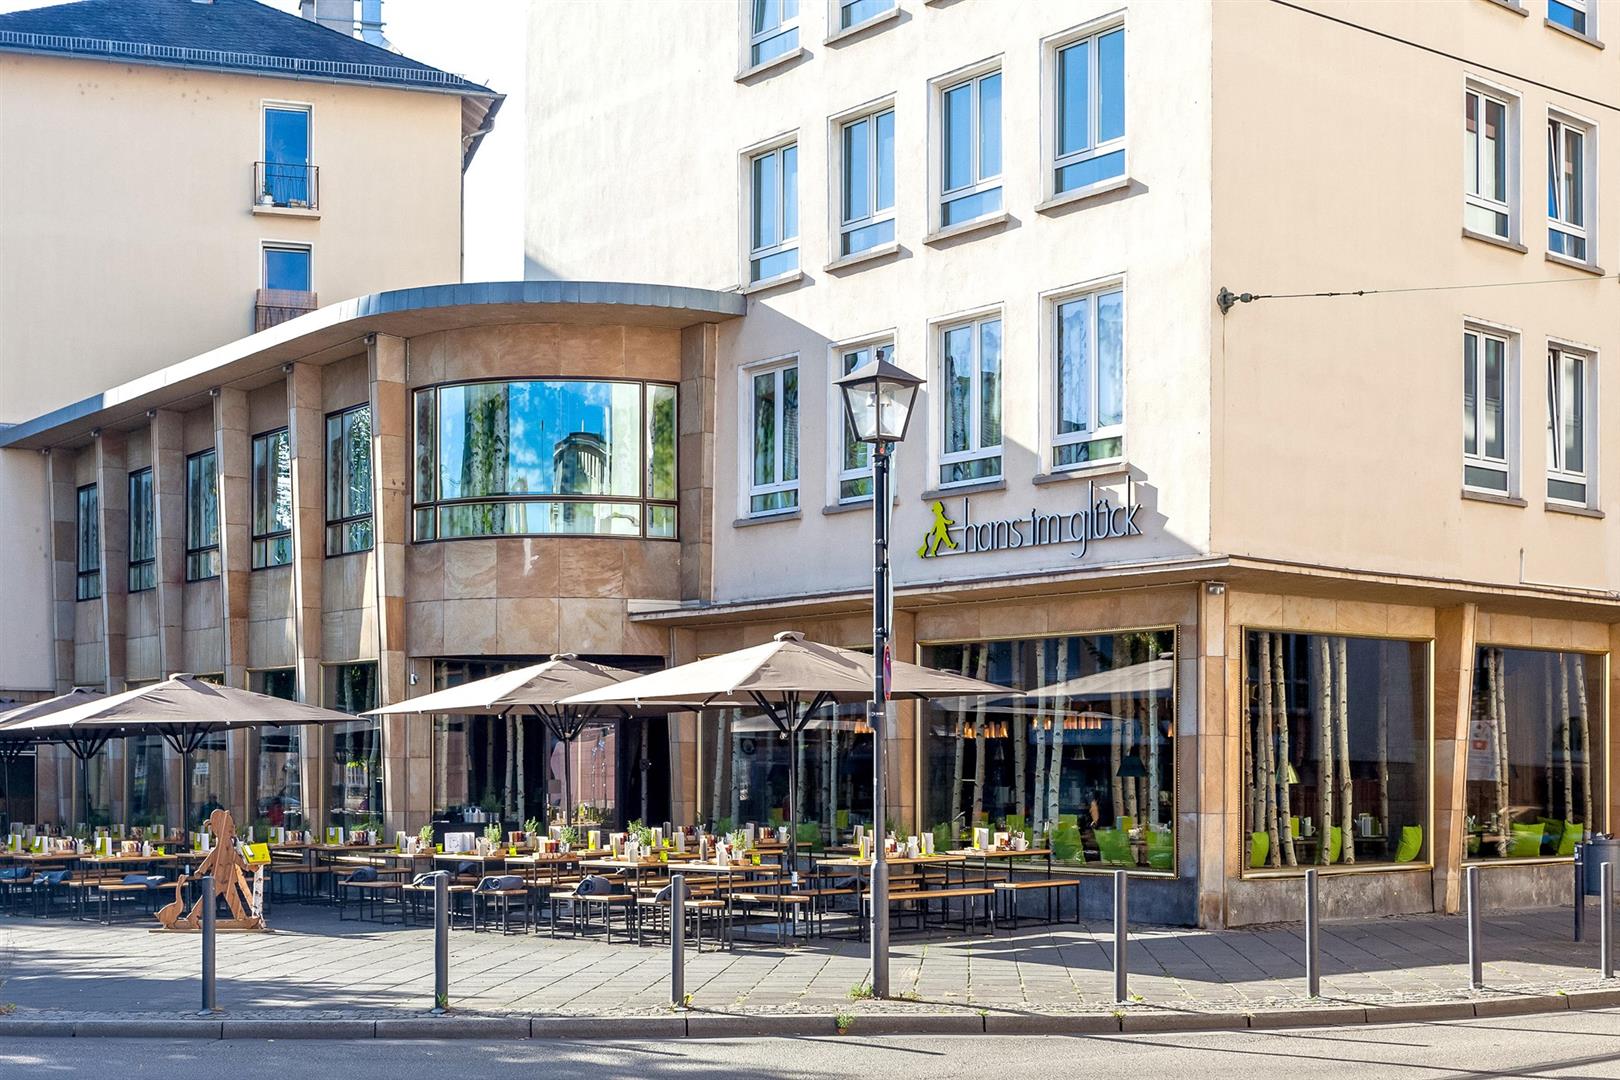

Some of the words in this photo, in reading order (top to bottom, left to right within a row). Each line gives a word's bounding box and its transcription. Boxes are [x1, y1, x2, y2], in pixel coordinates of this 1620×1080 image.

[963, 497, 1023, 553] hans
[1031, 508, 1061, 546] im
[1070, 475, 1142, 558] glück
